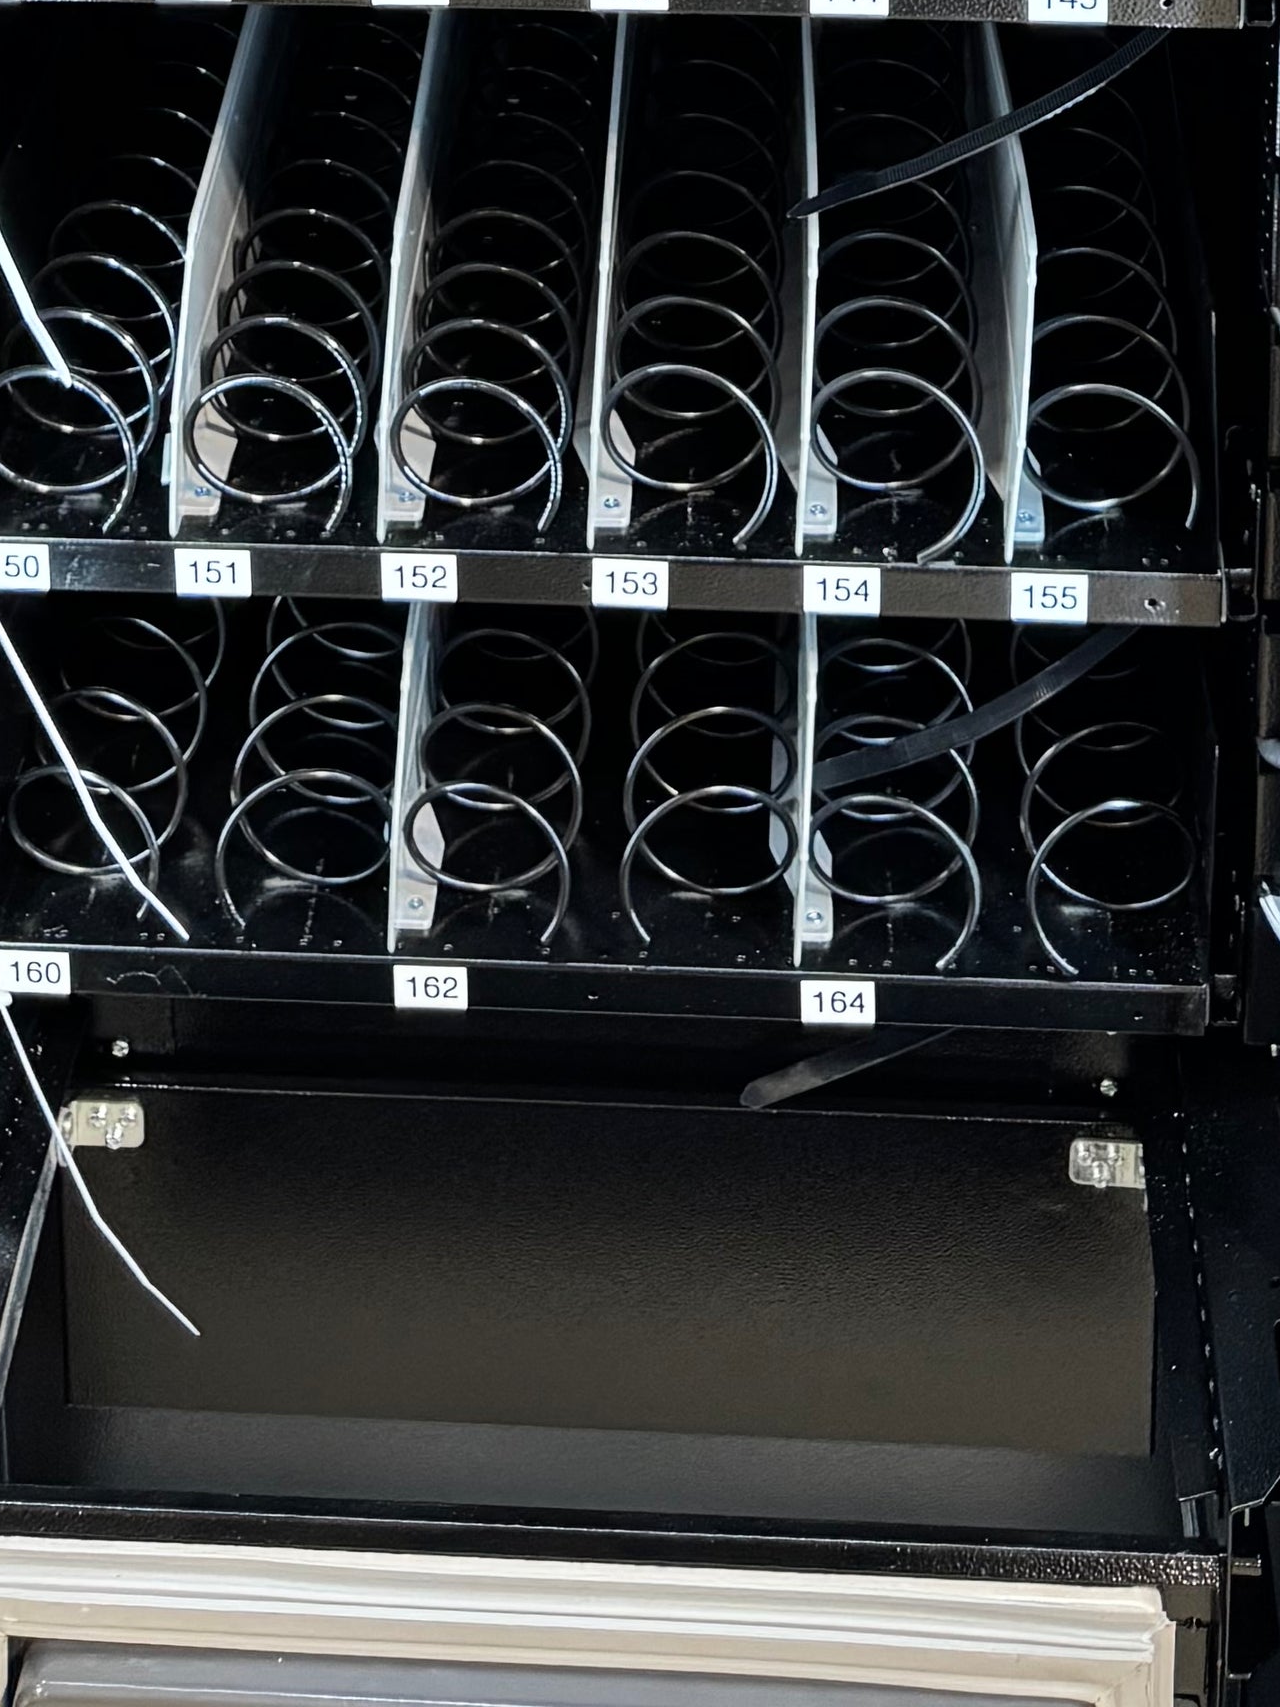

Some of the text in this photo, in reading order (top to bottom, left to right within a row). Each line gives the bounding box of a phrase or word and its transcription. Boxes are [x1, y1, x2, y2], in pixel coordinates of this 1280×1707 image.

[190, 561, 237, 584] 151
[396, 565, 449, 590] 152
[606, 571, 658, 595] 153
[818, 578, 870, 603] 154
[1024, 585, 1078, 610] 155
[11, 961, 61, 985] 160
[407, 976, 458, 999] 162
[813, 991, 865, 1015] 164
